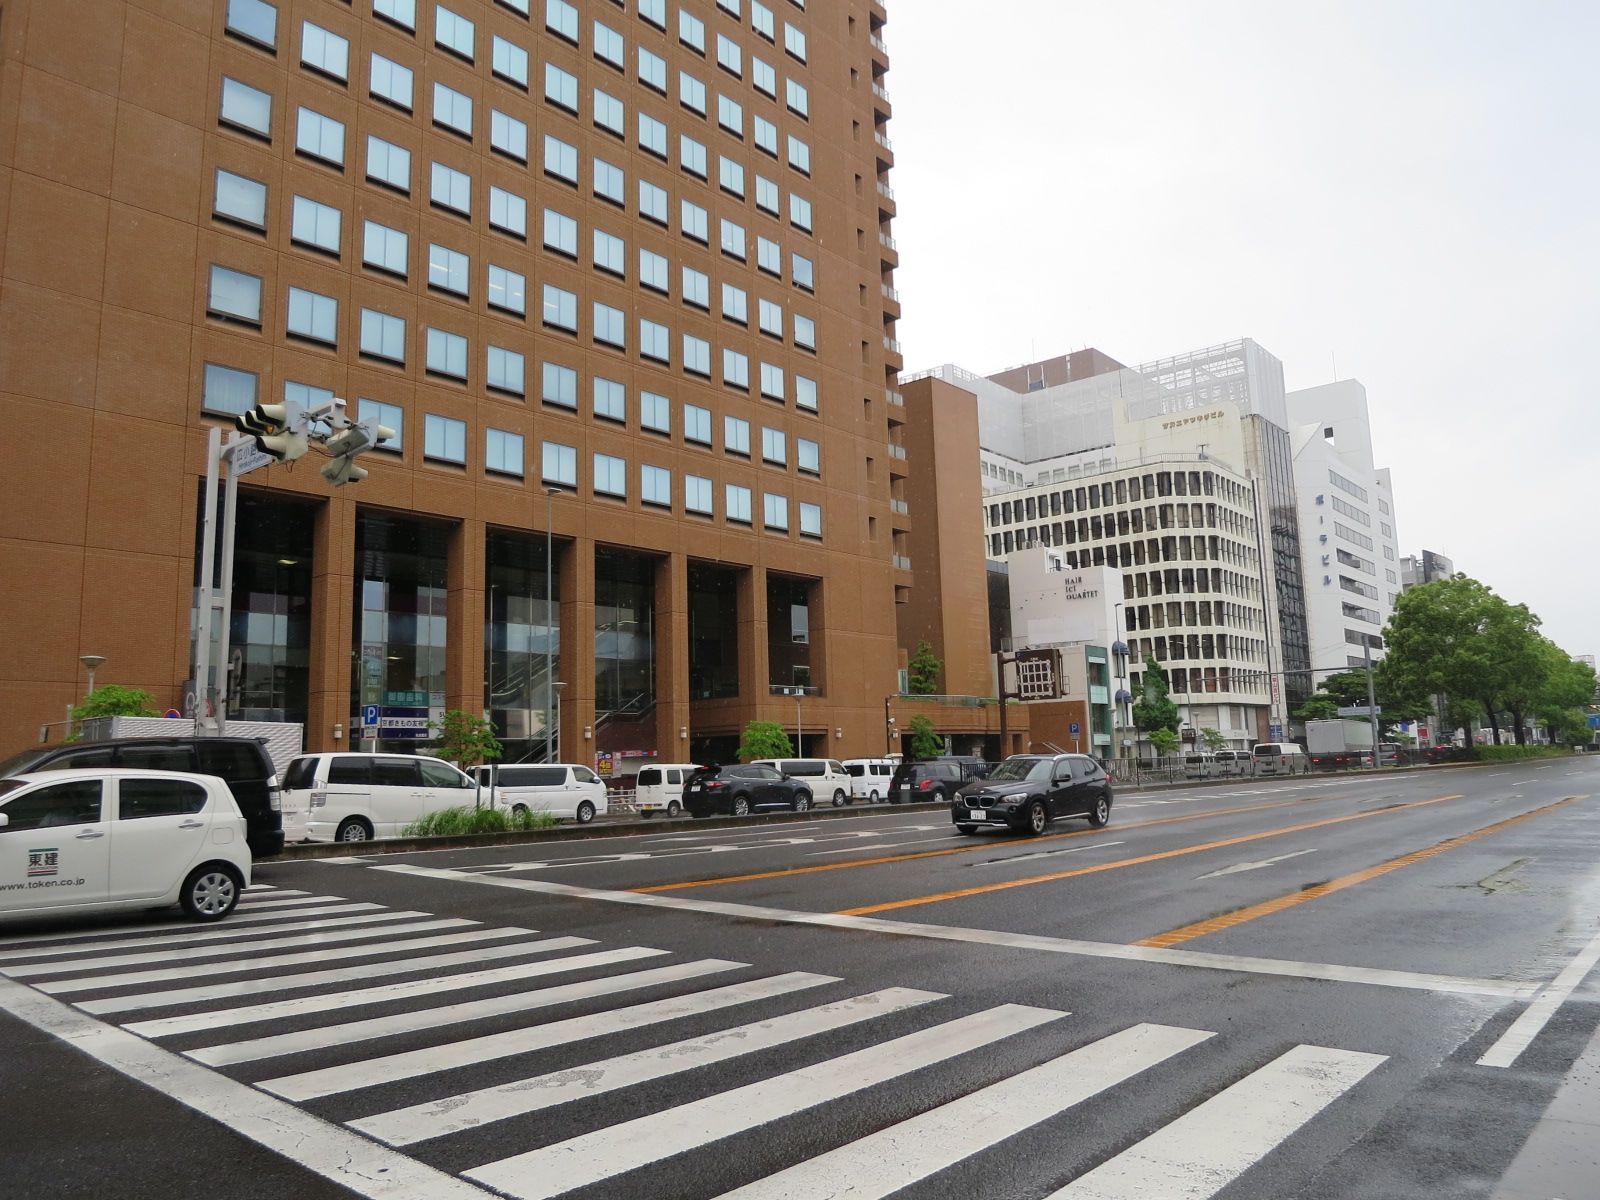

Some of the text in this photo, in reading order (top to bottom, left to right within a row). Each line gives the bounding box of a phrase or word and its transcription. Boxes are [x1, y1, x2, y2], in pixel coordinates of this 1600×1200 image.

[1065, 576, 1082, 585] HAIR
[1066, 590, 1098, 600] QUARTET
[28, 852, 58, 866] 東建
[0, 878, 86, 891] www.token.co.jp
